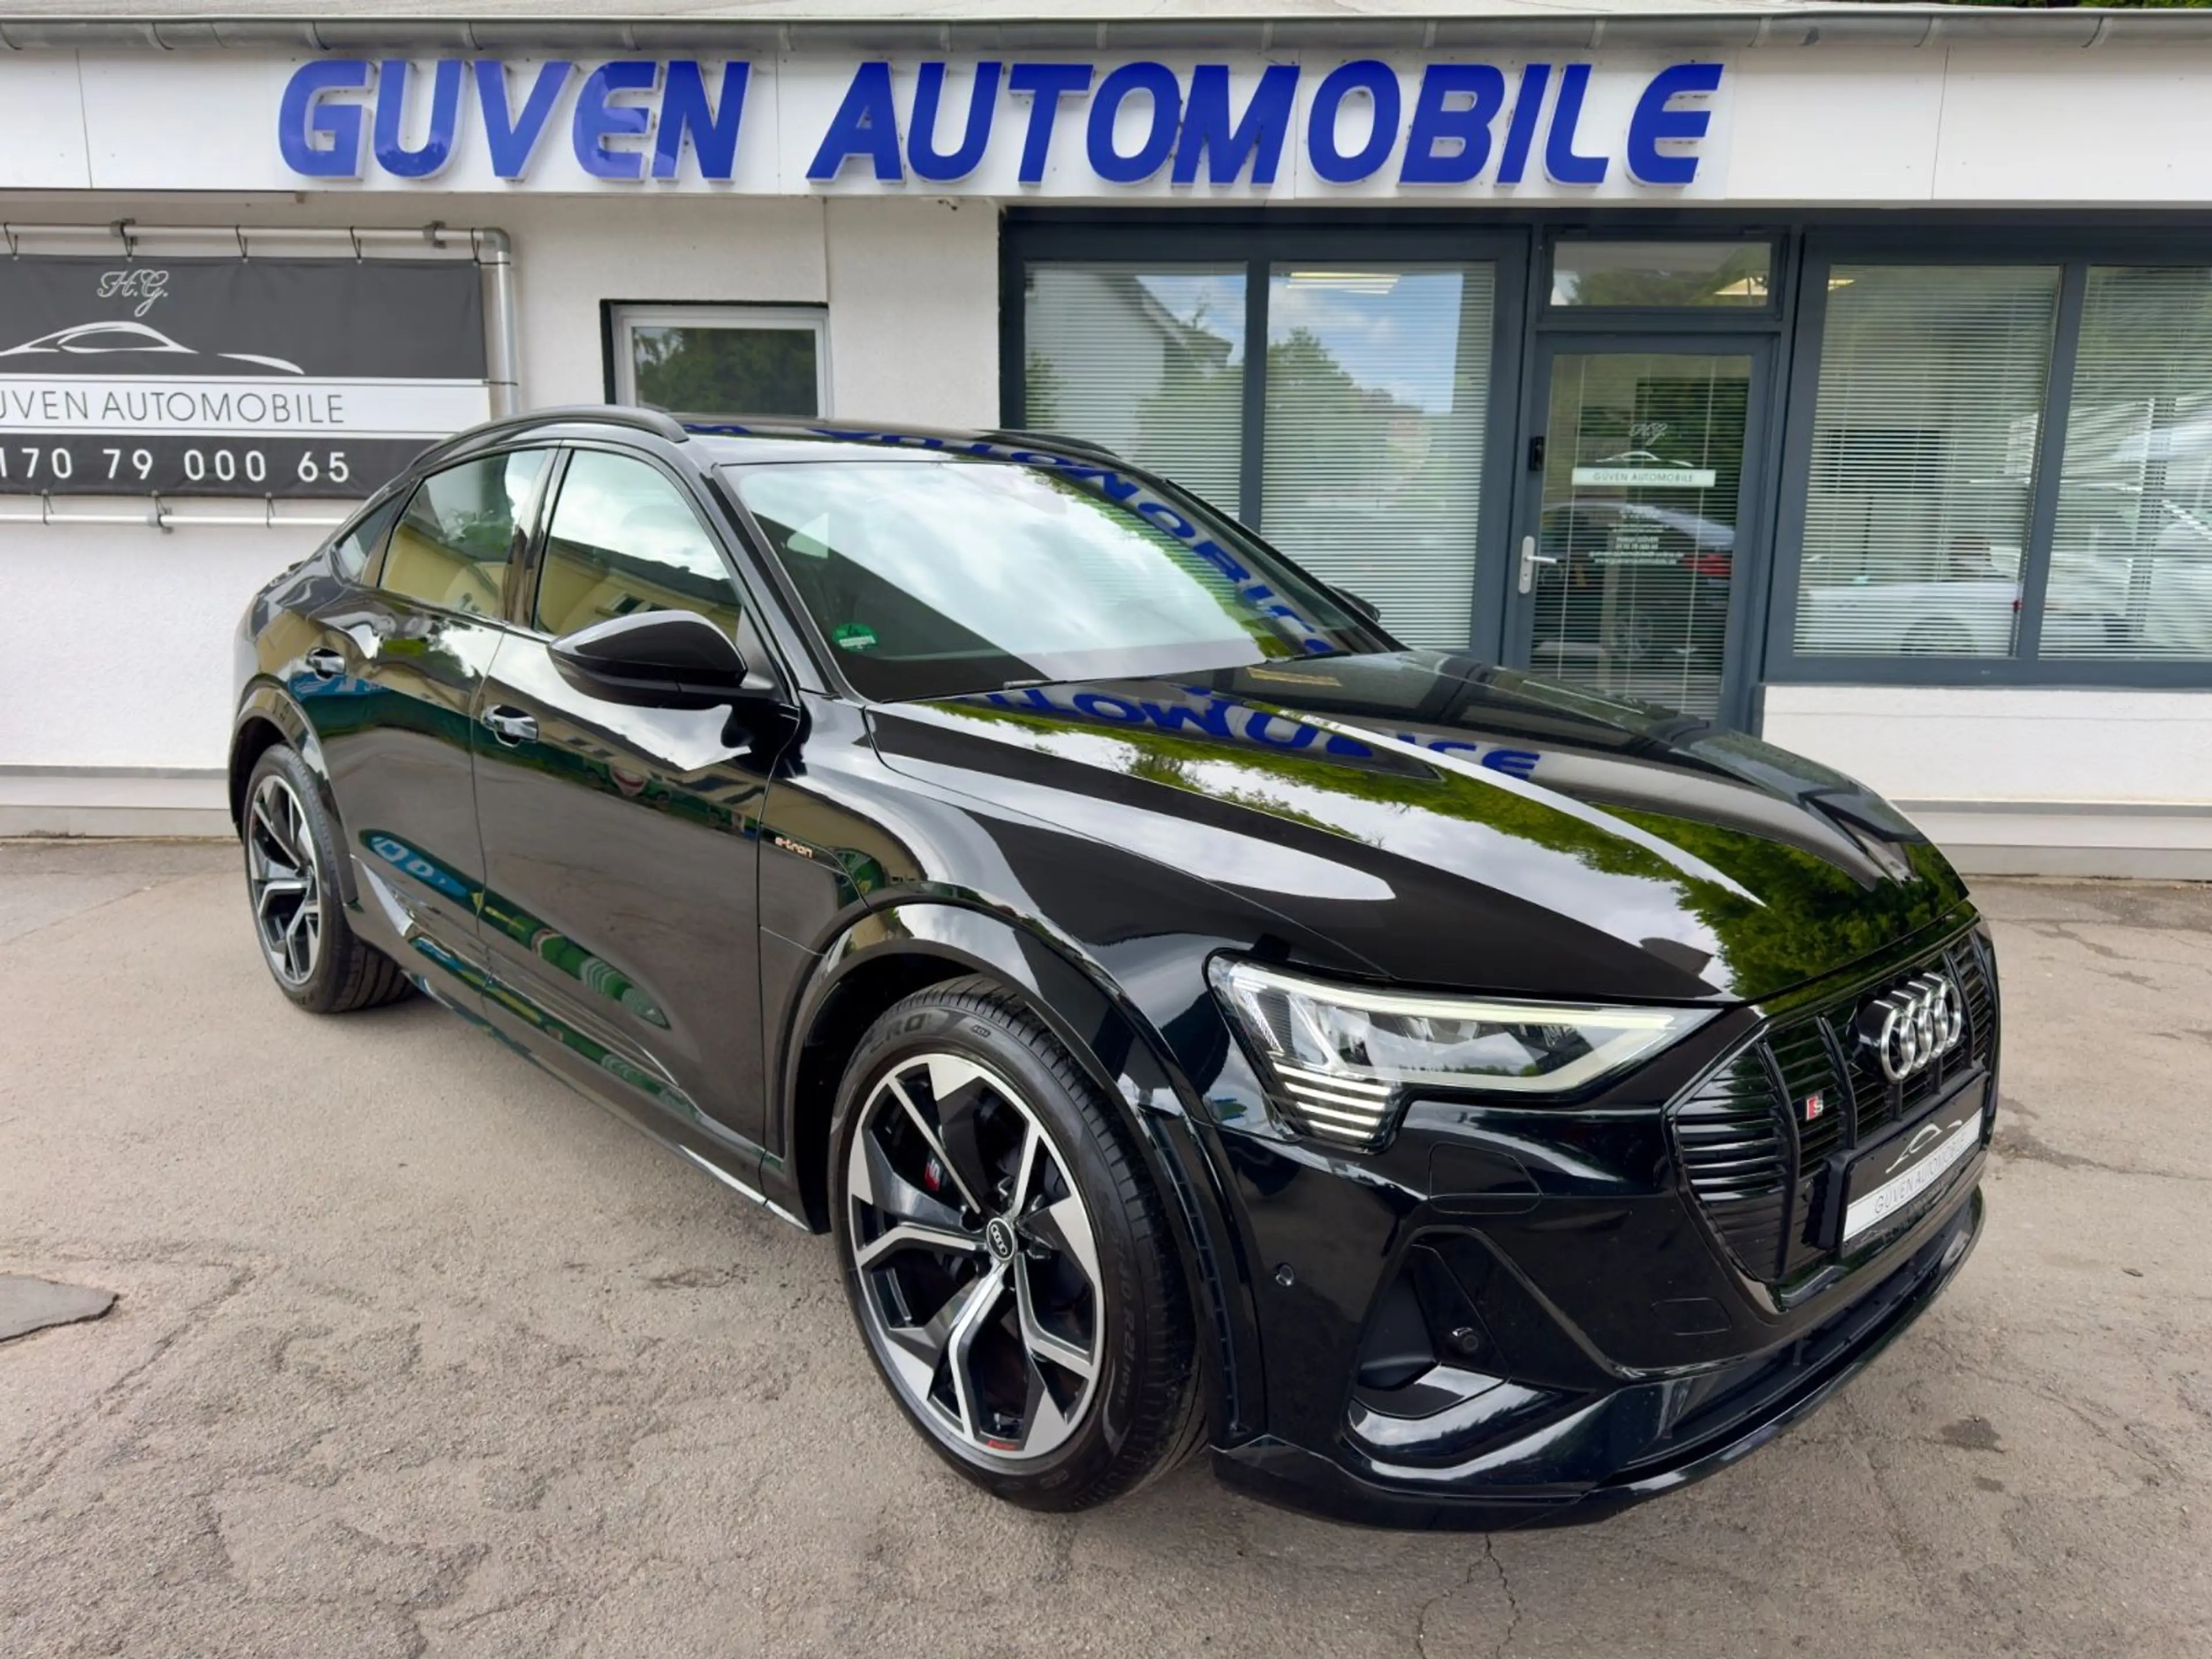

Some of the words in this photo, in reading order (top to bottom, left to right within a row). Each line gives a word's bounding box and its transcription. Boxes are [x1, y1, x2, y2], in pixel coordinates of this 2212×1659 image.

[278, 59, 751, 181] GUVEN
[806, 59, 1725, 187] AUTOMOBILE
[101, 392, 344, 423] AUTOMOBILE
[103, 449, 153, 480] 79
[184, 449, 266, 482] 000
[297, 451, 349, 482] 65
